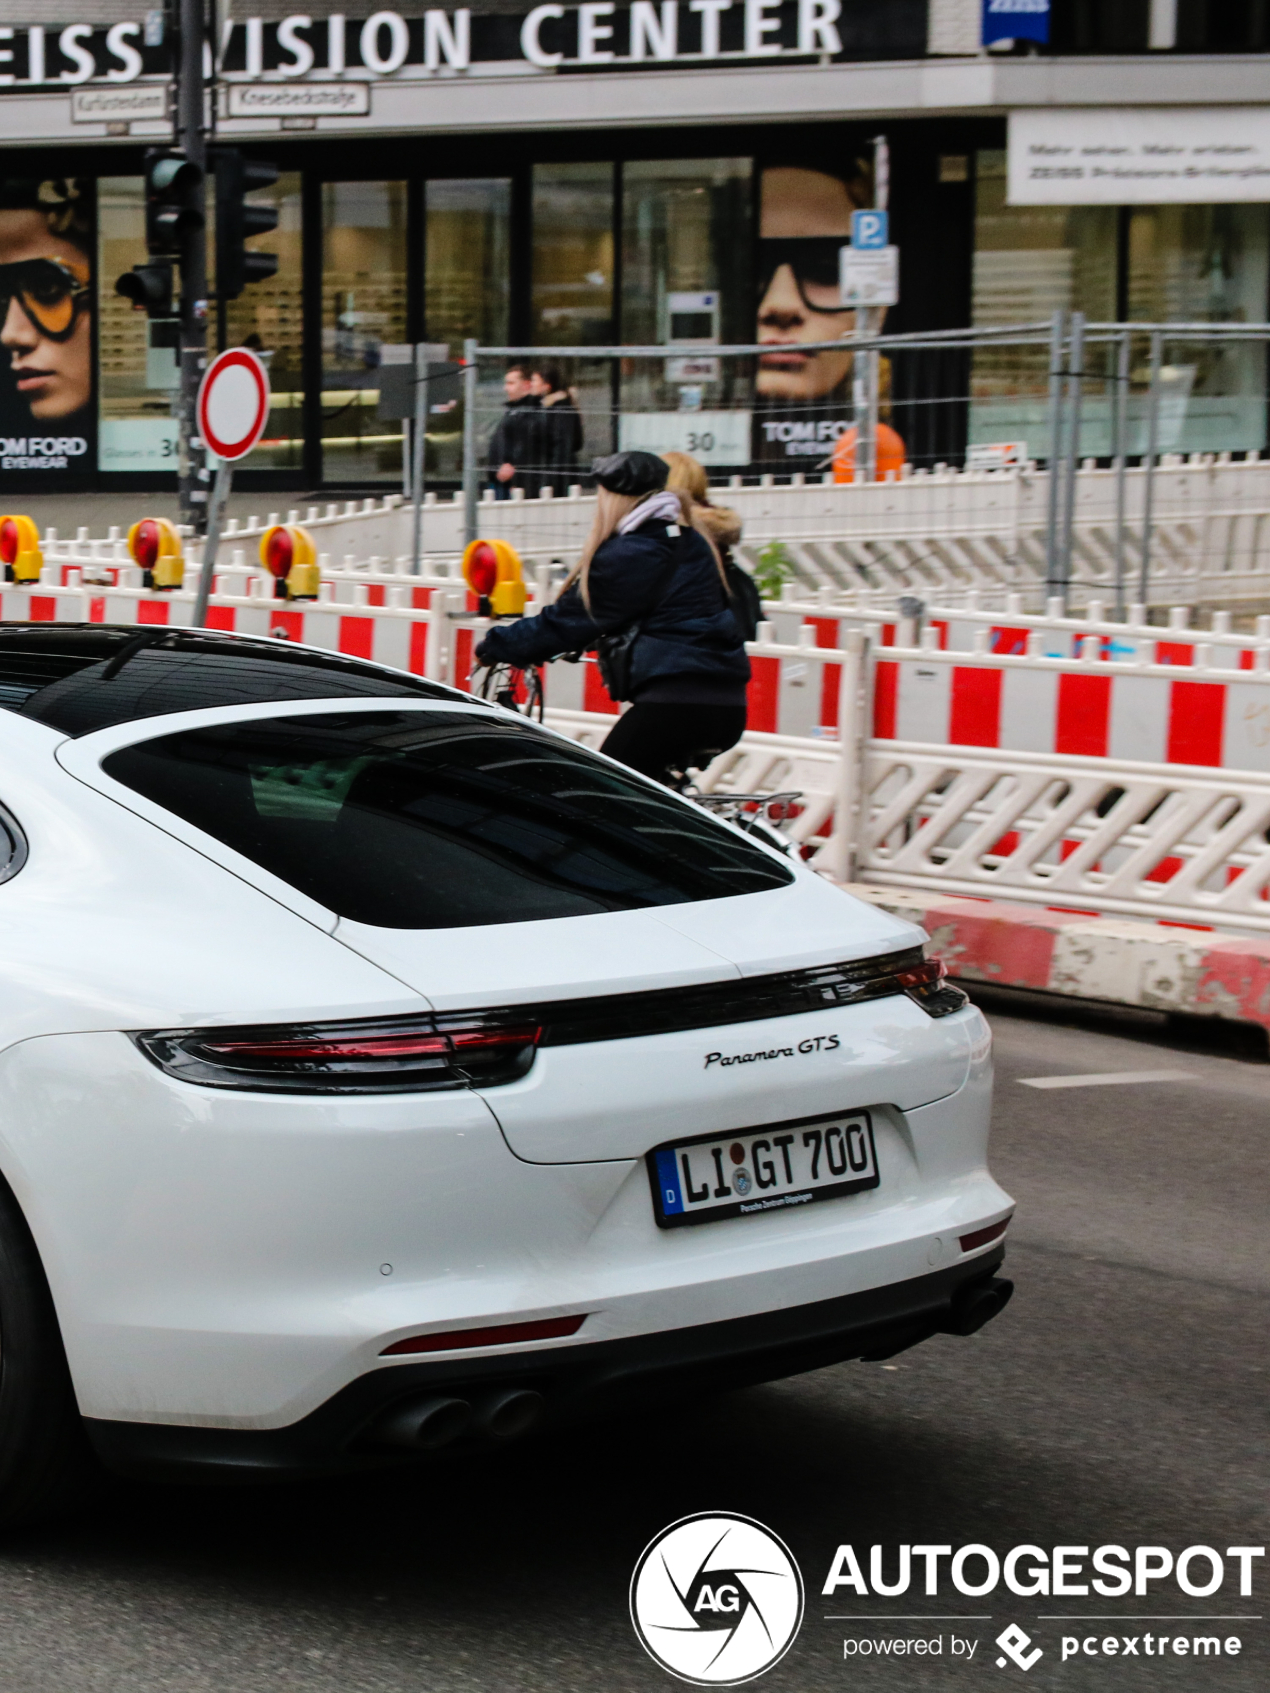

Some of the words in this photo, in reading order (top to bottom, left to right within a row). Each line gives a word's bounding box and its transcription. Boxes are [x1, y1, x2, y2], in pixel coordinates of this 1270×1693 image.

[520, 0, 843, 67] CENTER
[762, 421, 815, 442] TOM
[30, 437, 87, 456] FORD
[687, 432, 715, 452] 30
[1, 456, 68, 469] EYEWEAR
[704, 1047, 794, 1069] Panamera
[798, 1034, 840, 1052] GTS
[682, 1148, 731, 1203] LI
[751, 1135, 794, 1189] GT
[803, 1124, 867, 1179] 700
[666, 1190, 675, 1204] D
